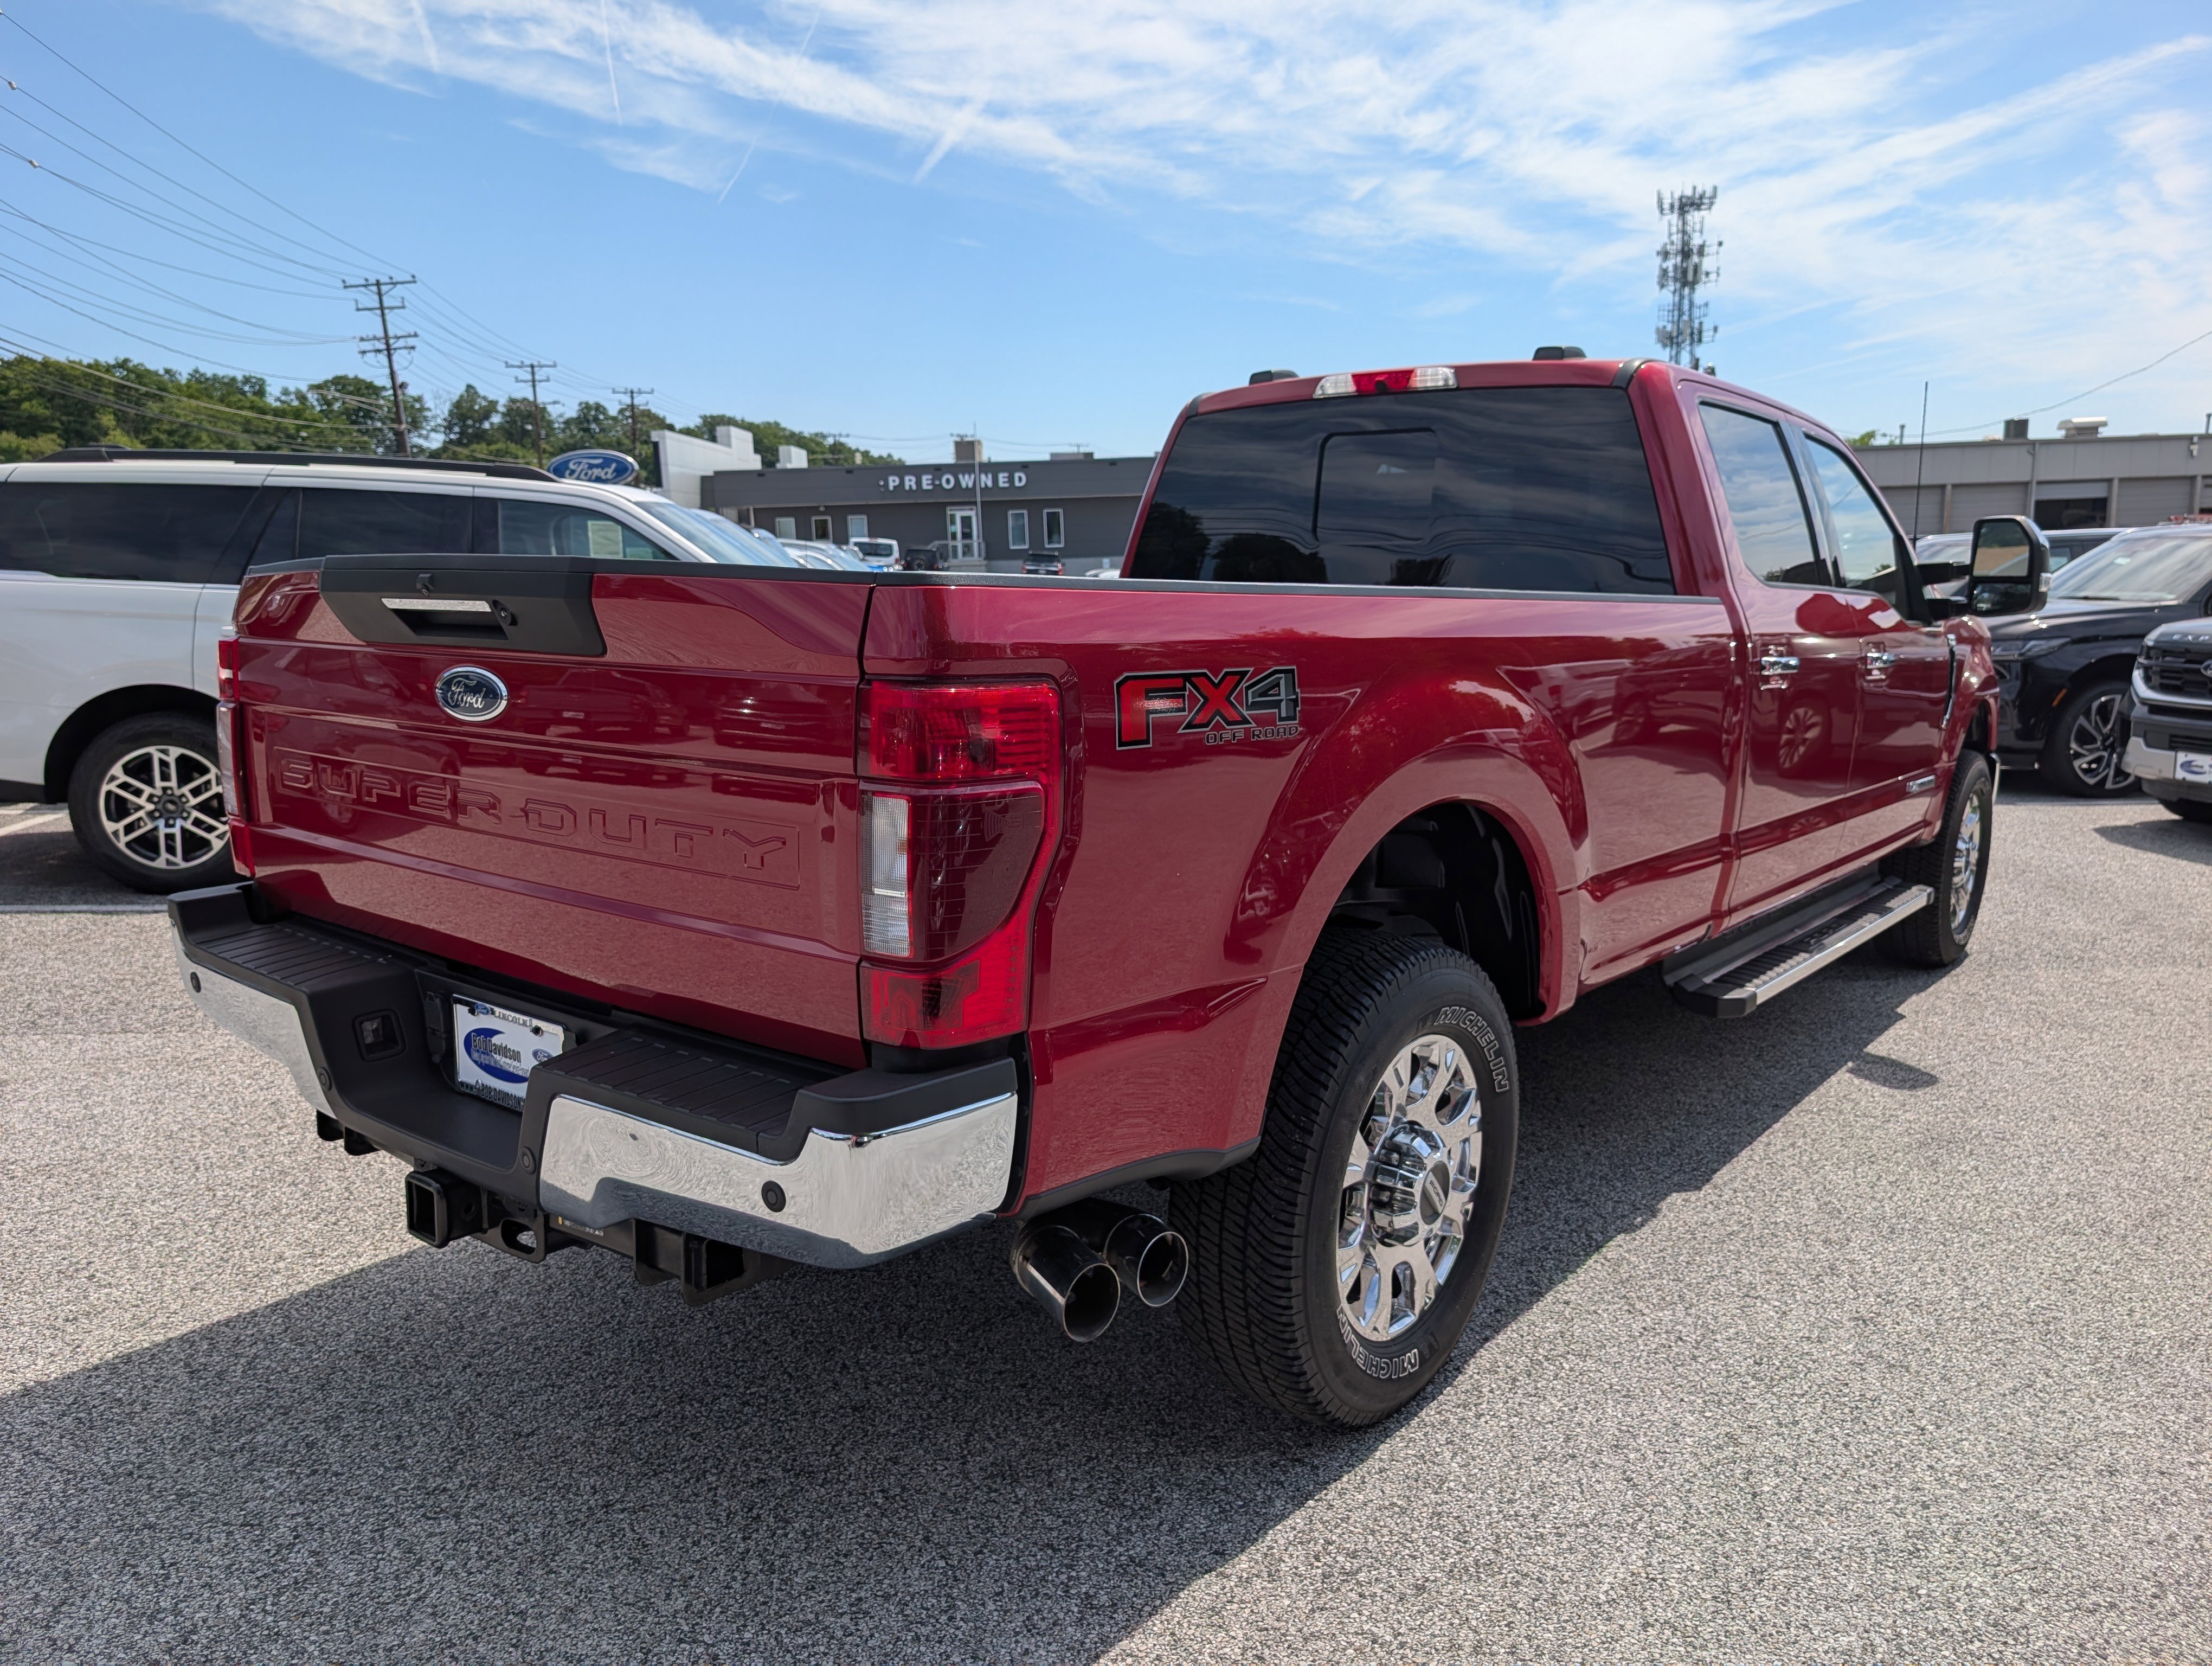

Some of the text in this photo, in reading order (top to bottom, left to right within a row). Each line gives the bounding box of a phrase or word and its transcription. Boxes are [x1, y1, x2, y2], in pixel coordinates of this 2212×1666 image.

[565, 458, 617, 480] Ford
[888, 471, 1027, 491] PRE-OWNED
[448, 678, 486, 709] Ford
[1114, 666, 1301, 750] FX4
[1205, 725, 1300, 745] OFF ROAD
[281, 759, 787, 870] SUPER DUTY
[494, 1010, 530, 1027] LINCOLN
[472, 1033, 487, 1051] Bob
[488, 1037, 522, 1063] Davidson
[1433, 1006, 1510, 1093] MICHELIN
[1429, 1180, 1443, 1207] FORD
[1336, 1304, 1419, 1379] MICHELIN
